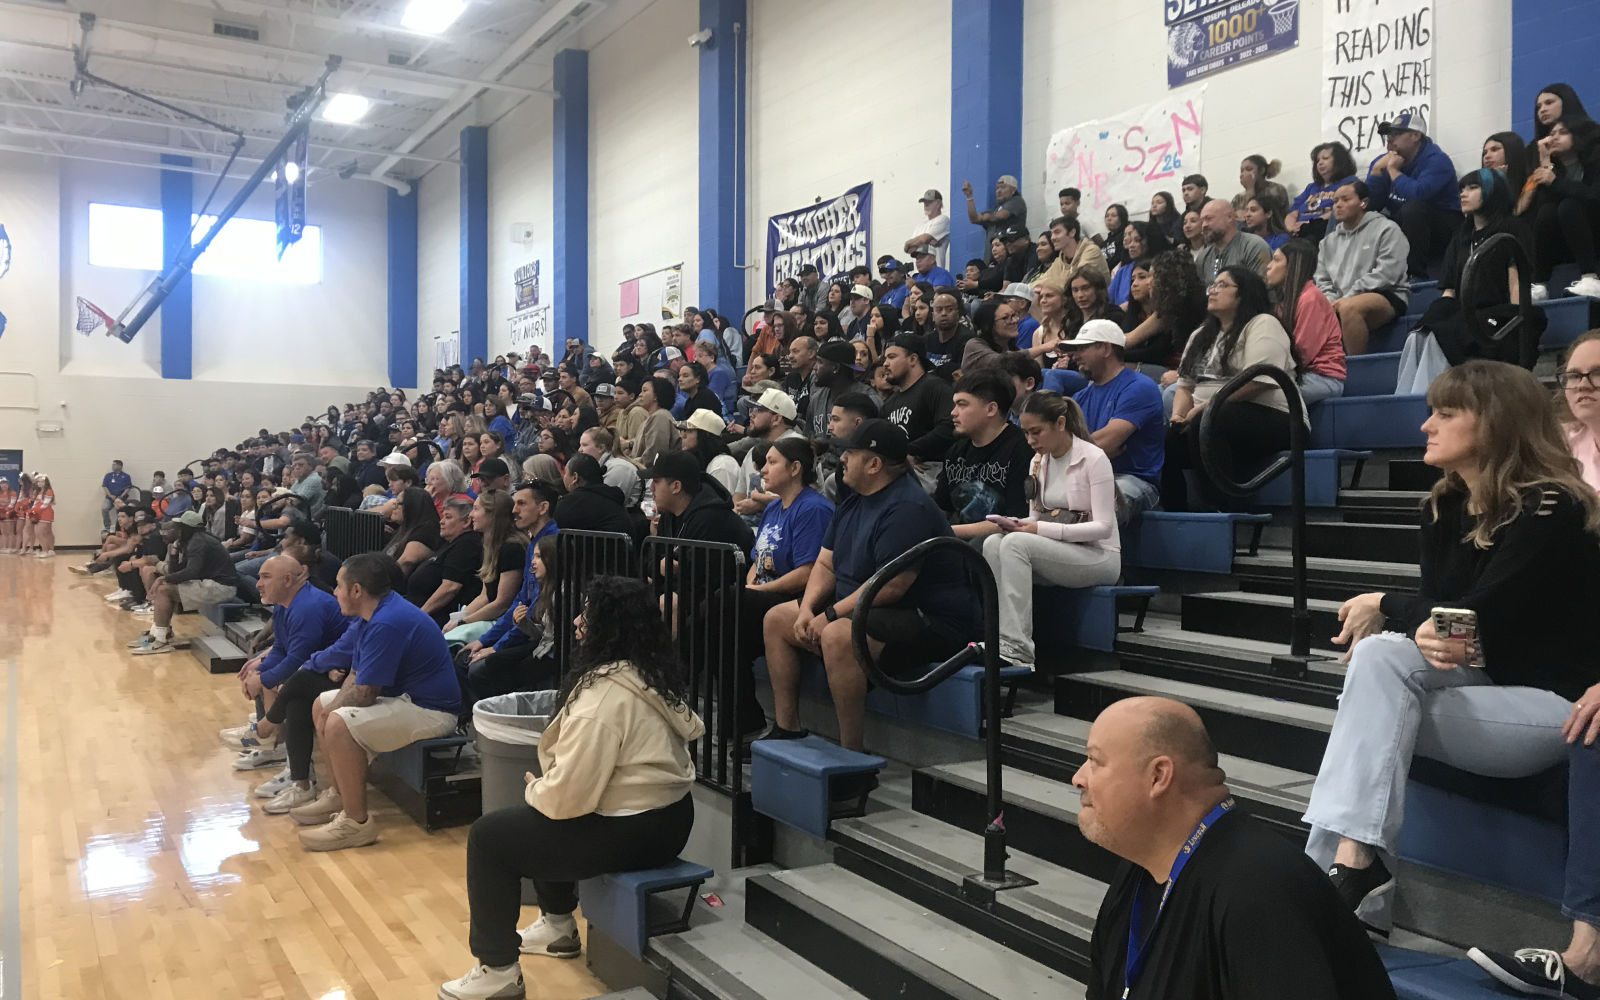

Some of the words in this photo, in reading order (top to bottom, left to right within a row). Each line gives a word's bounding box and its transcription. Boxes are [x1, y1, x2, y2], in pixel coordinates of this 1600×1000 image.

[1202, 9, 1227, 25] JOSEPH
[1336, 7, 1430, 65] READING
[1200, 41, 1232, 60] CAREER
[1232, 30, 1265, 50] POINTS
[1328, 71, 1375, 108] THIS
[1382, 58, 1431, 98] WERE
[1162, 152, 1181, 172] 26
[778, 193, 861, 253] BLEACHER
